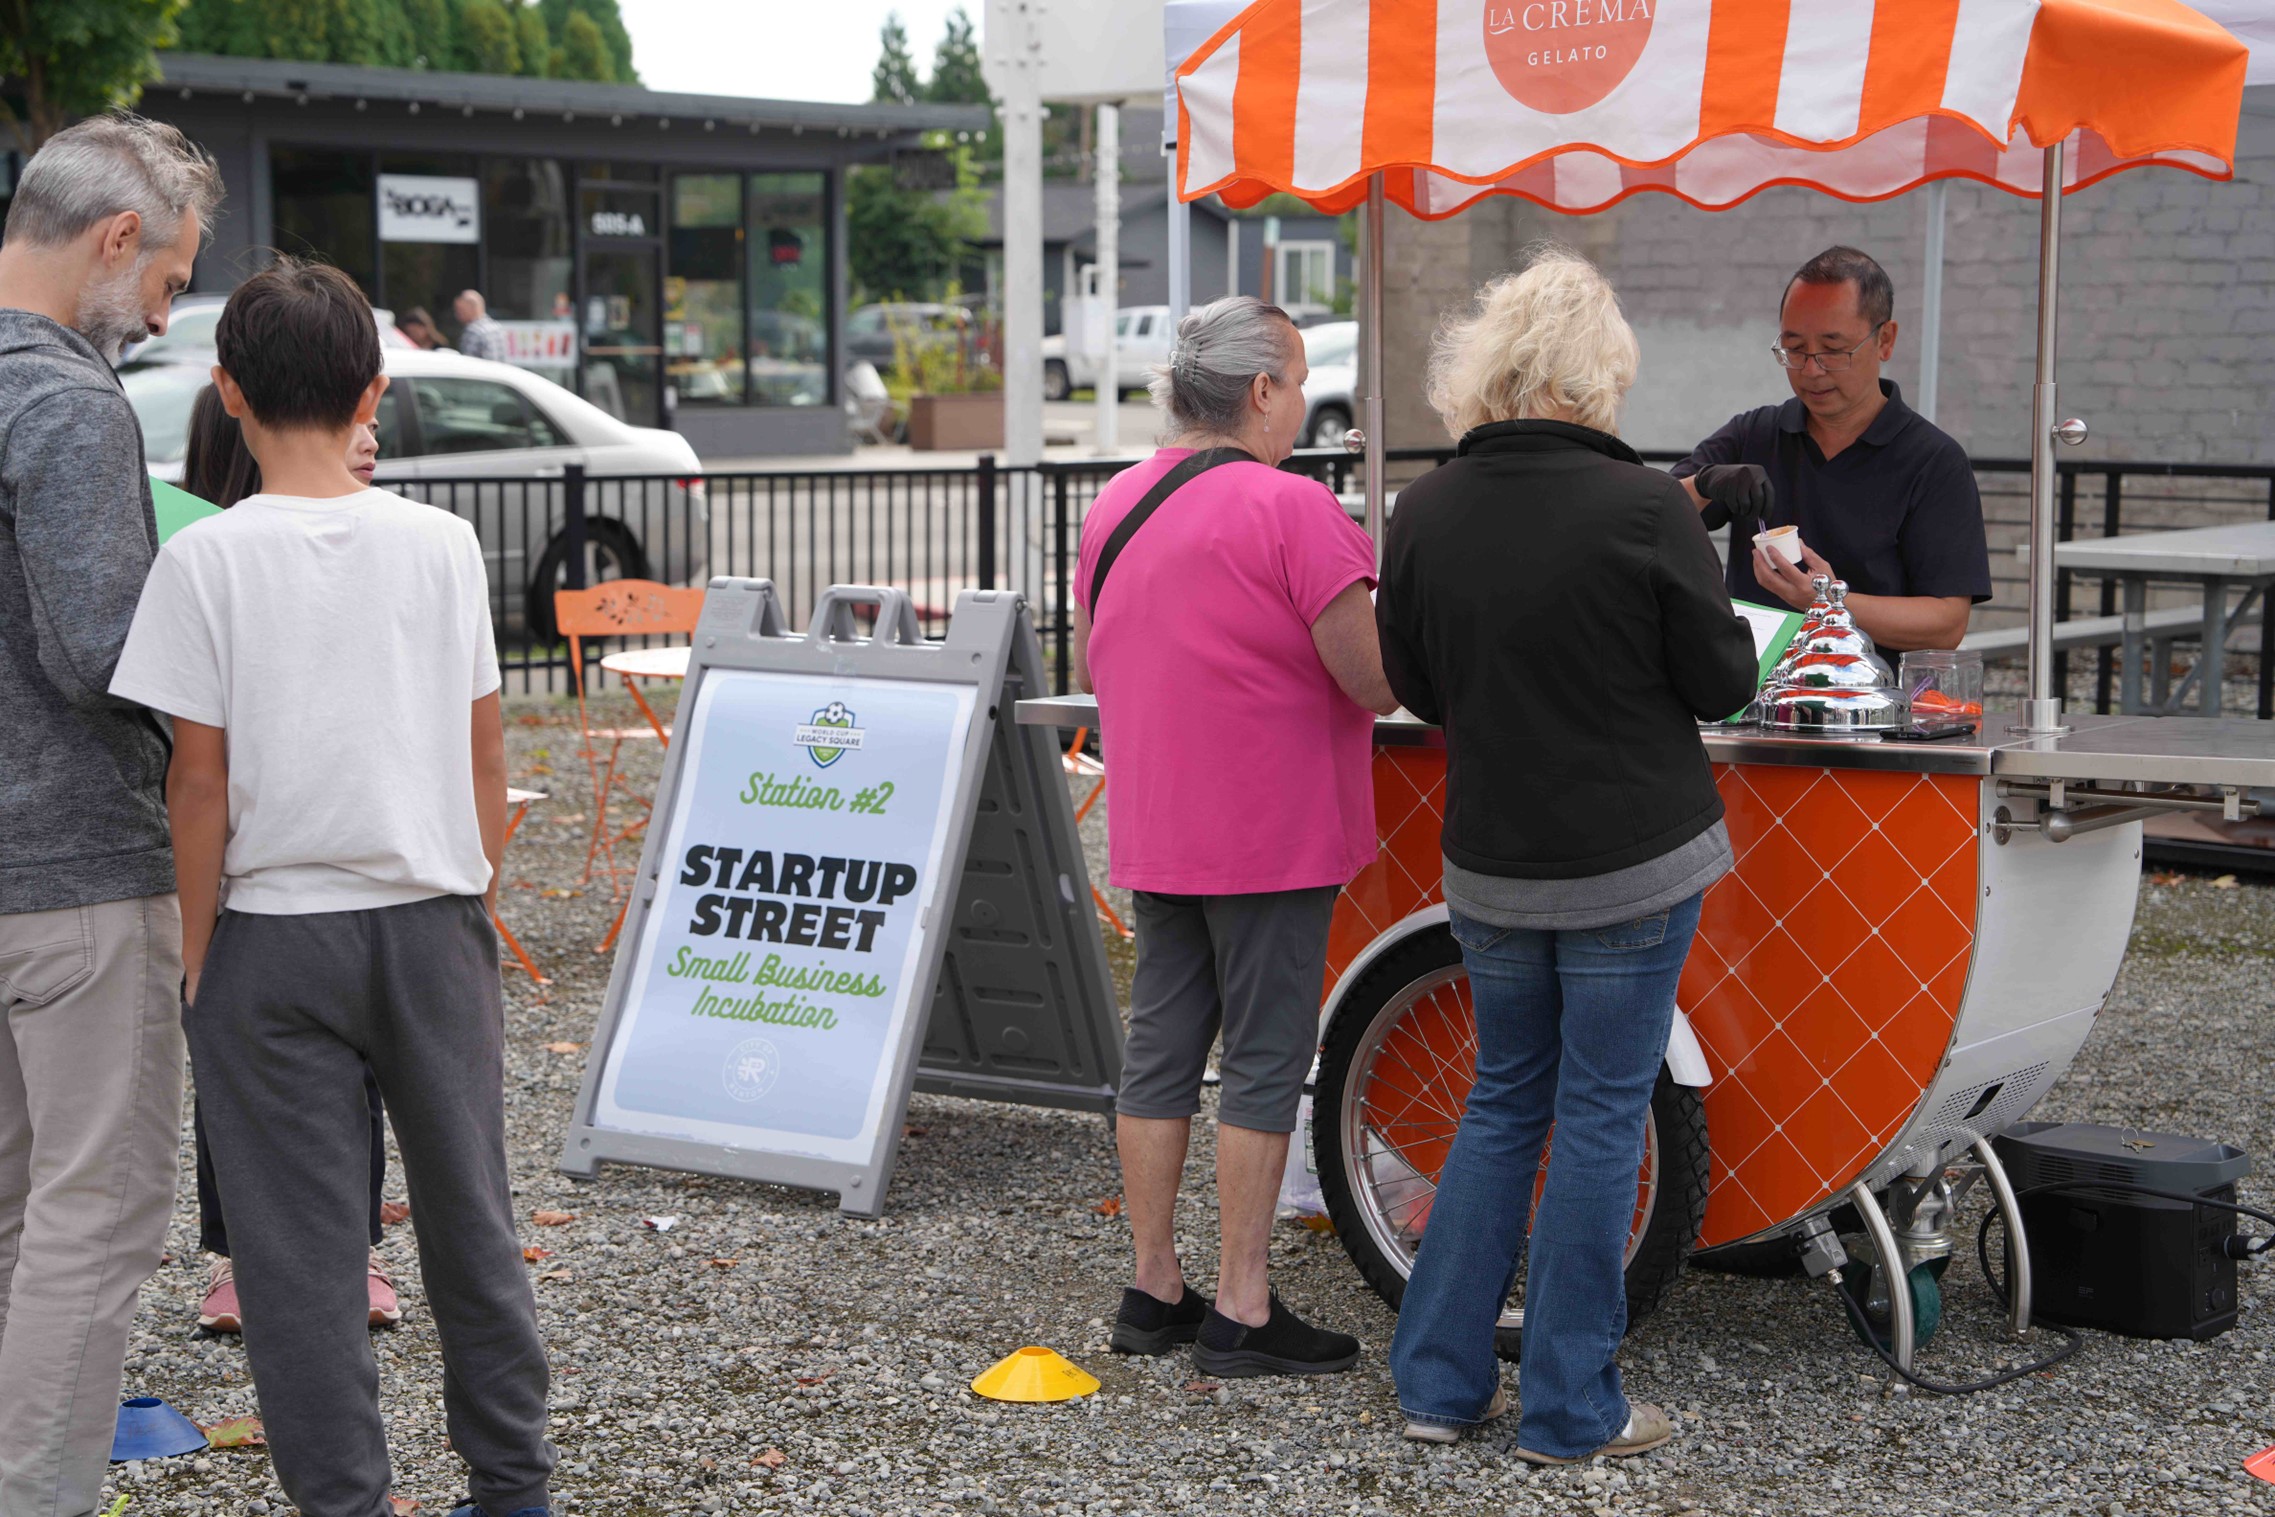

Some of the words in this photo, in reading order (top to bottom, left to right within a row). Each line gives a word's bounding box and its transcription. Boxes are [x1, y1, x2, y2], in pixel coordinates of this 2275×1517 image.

[1489, 8, 1515, 27] LA
[1528, 45, 1607, 66] GELATO
[796, 734, 828, 744] LEGACY
[828, 736, 861, 746] SQUARE
[811, 728, 835, 737] WORLD
[739, 771, 846, 811] Station
[848, 781, 895, 815] #2
[680, 844, 917, 906] STARTUP
[689, 893, 887, 953] STREET
[667, 945, 751, 984] Small
[752, 953, 887, 998] Business
[691, 984, 839, 1031] Incubation
